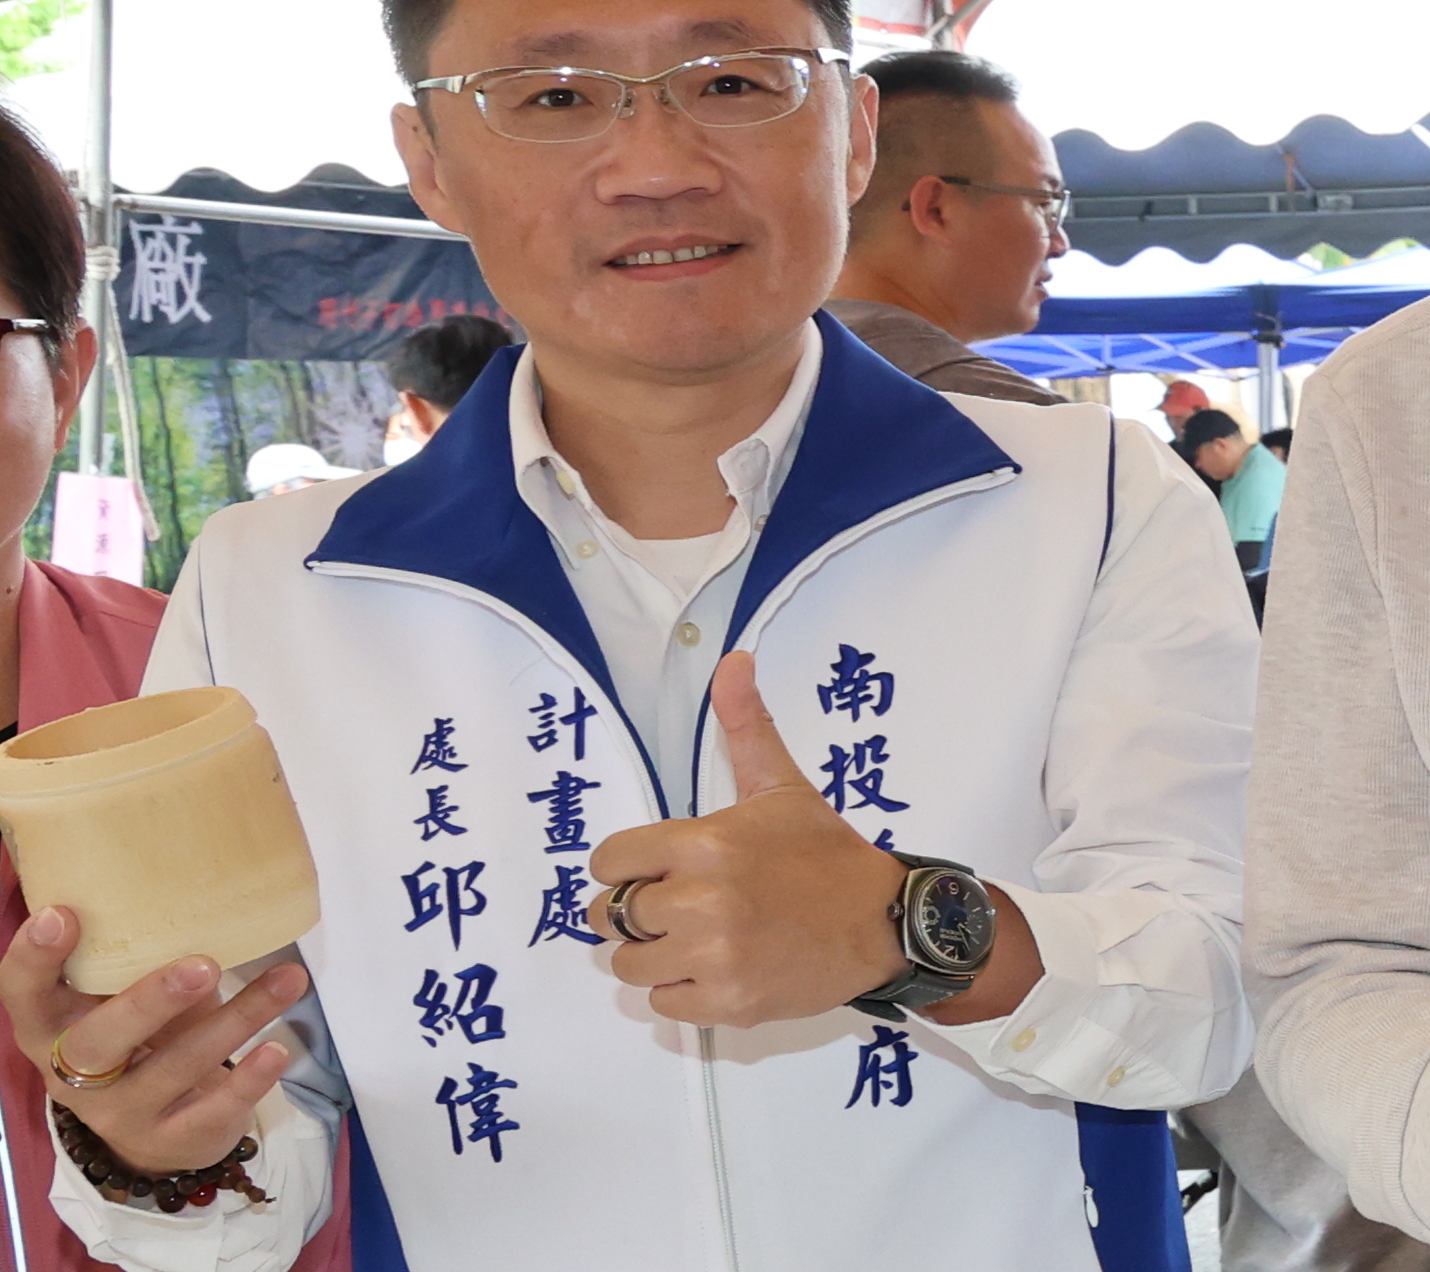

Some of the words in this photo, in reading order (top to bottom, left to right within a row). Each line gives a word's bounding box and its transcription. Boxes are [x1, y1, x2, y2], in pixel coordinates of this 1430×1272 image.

[129, 215, 211, 324] 廠
[526, 686, 602, 950] 計畫處
